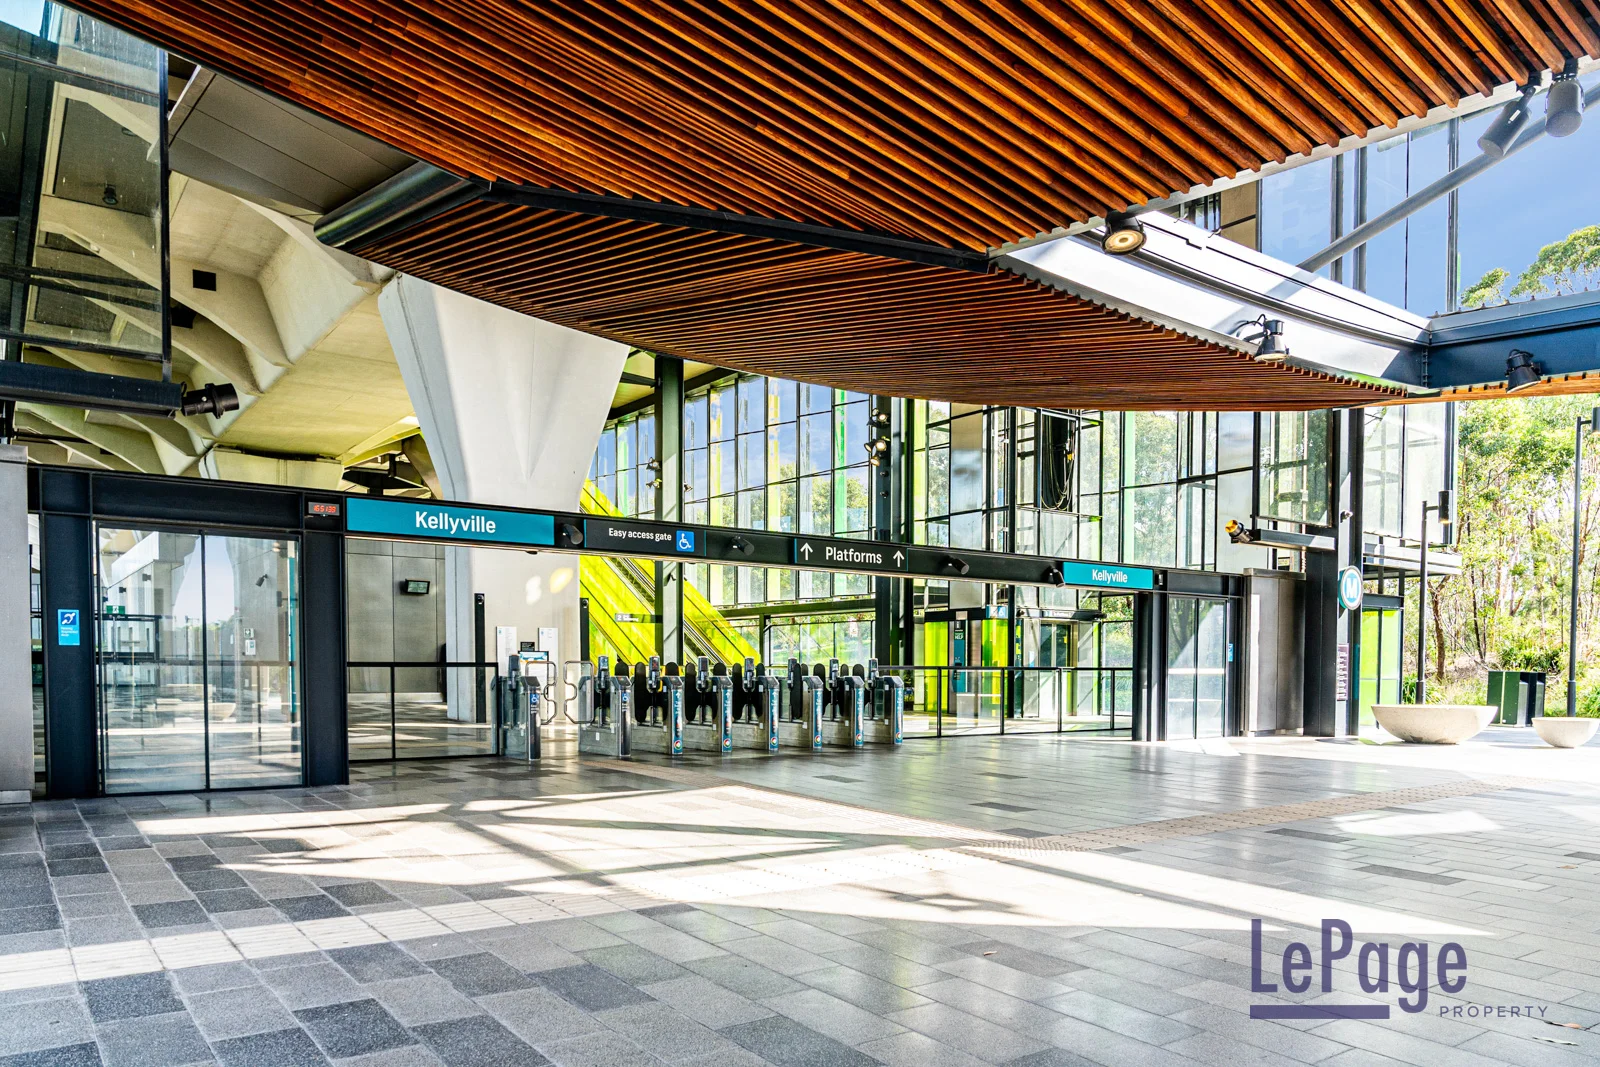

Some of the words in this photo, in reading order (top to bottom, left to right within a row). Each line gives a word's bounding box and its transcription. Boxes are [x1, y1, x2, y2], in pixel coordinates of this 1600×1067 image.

[415, 510, 496, 535] Kellyville
[608, 527, 627, 539] Easy
[627, 530, 655, 540] access
[654, 532, 672, 542] gate
[825, 545, 883, 565] Platforms
[1091, 568, 1129, 584] Kellyville
[1345, 577, 1358, 599] M
